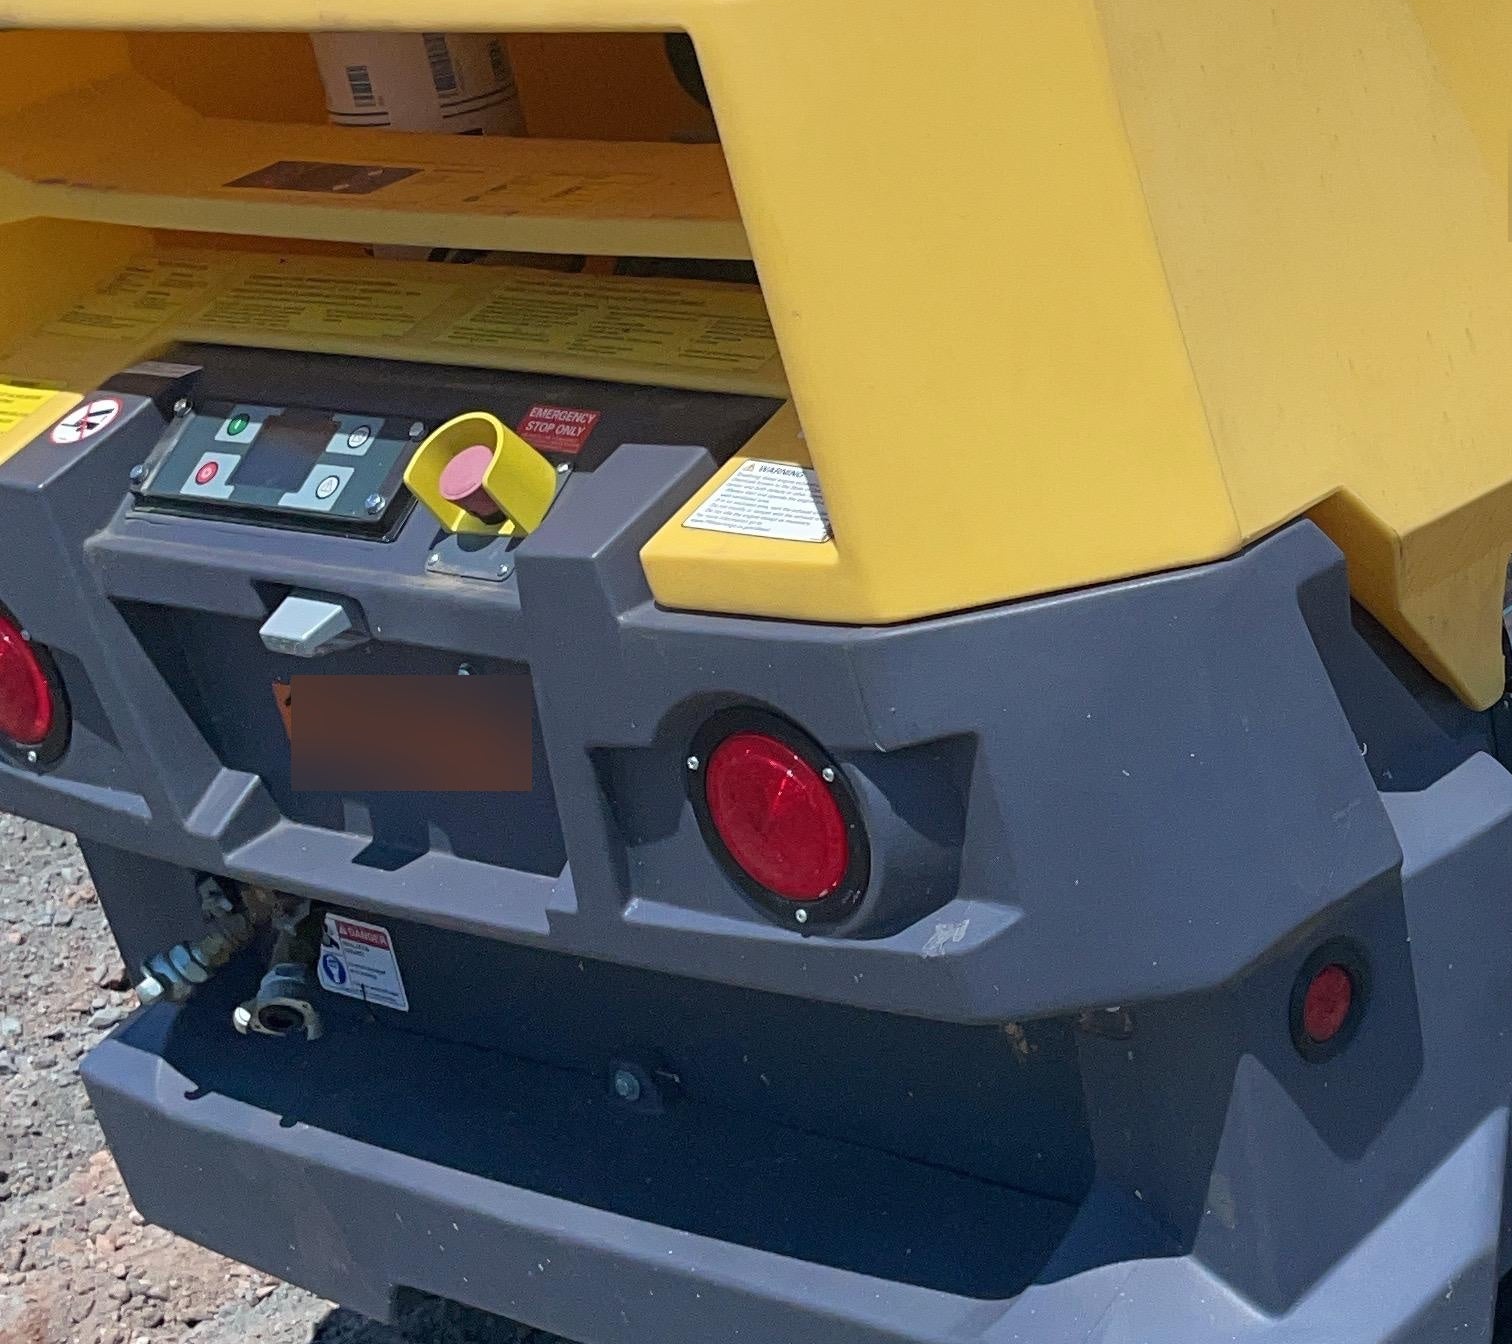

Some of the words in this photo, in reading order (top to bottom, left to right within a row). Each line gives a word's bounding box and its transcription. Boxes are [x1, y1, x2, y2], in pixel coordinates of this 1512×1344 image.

[529, 407, 597, 424] EMERGENCY
[525, 421, 556, 433] STOP
[555, 425, 586, 437] ONLY
